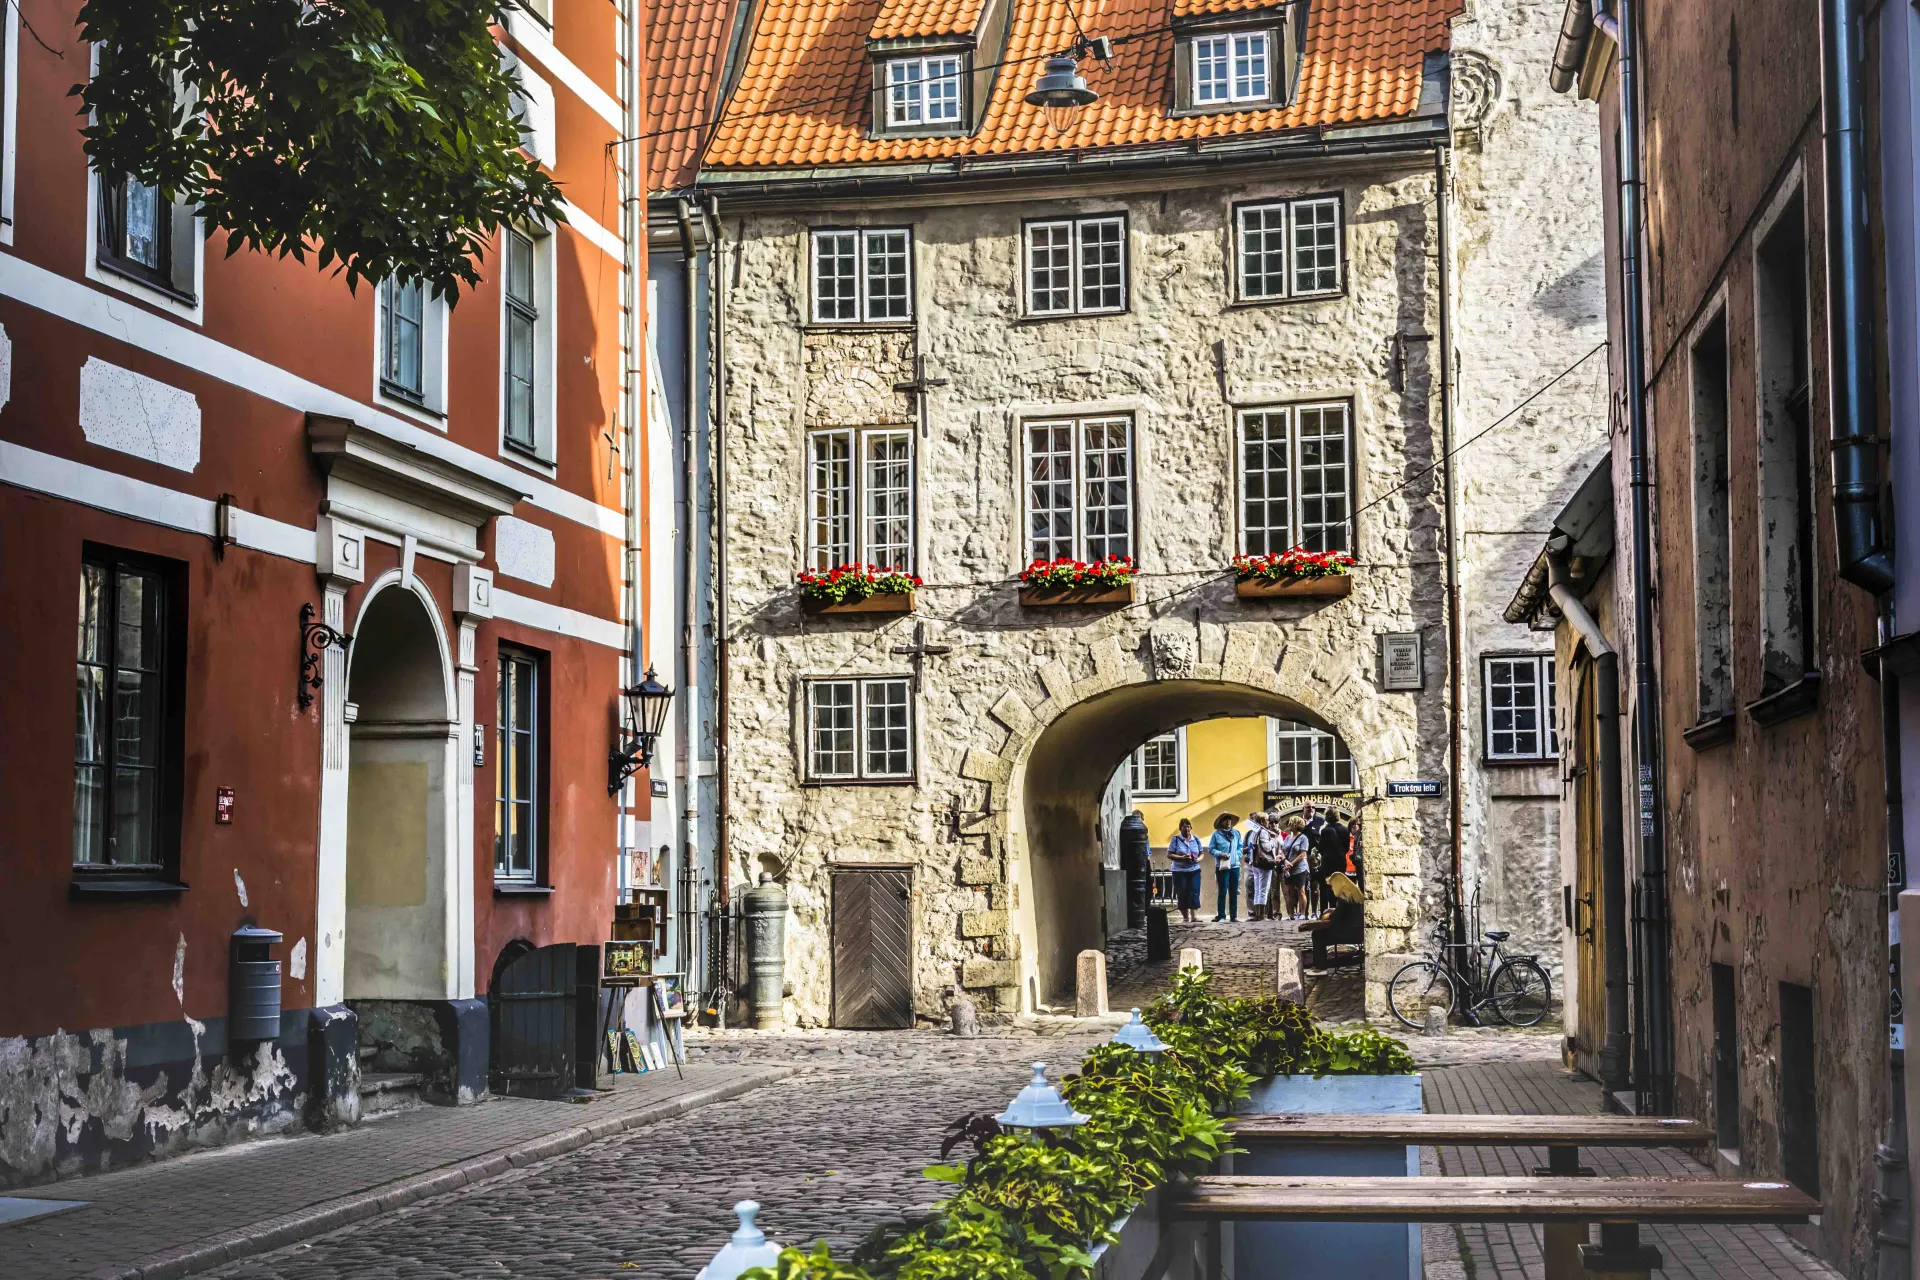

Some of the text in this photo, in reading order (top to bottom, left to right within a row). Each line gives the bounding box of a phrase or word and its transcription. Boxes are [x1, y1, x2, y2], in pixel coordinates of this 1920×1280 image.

[1275, 800, 1291, 812] THE
[1294, 794, 1331, 806] AMBER
[1332, 798, 1356, 813] ROOM
